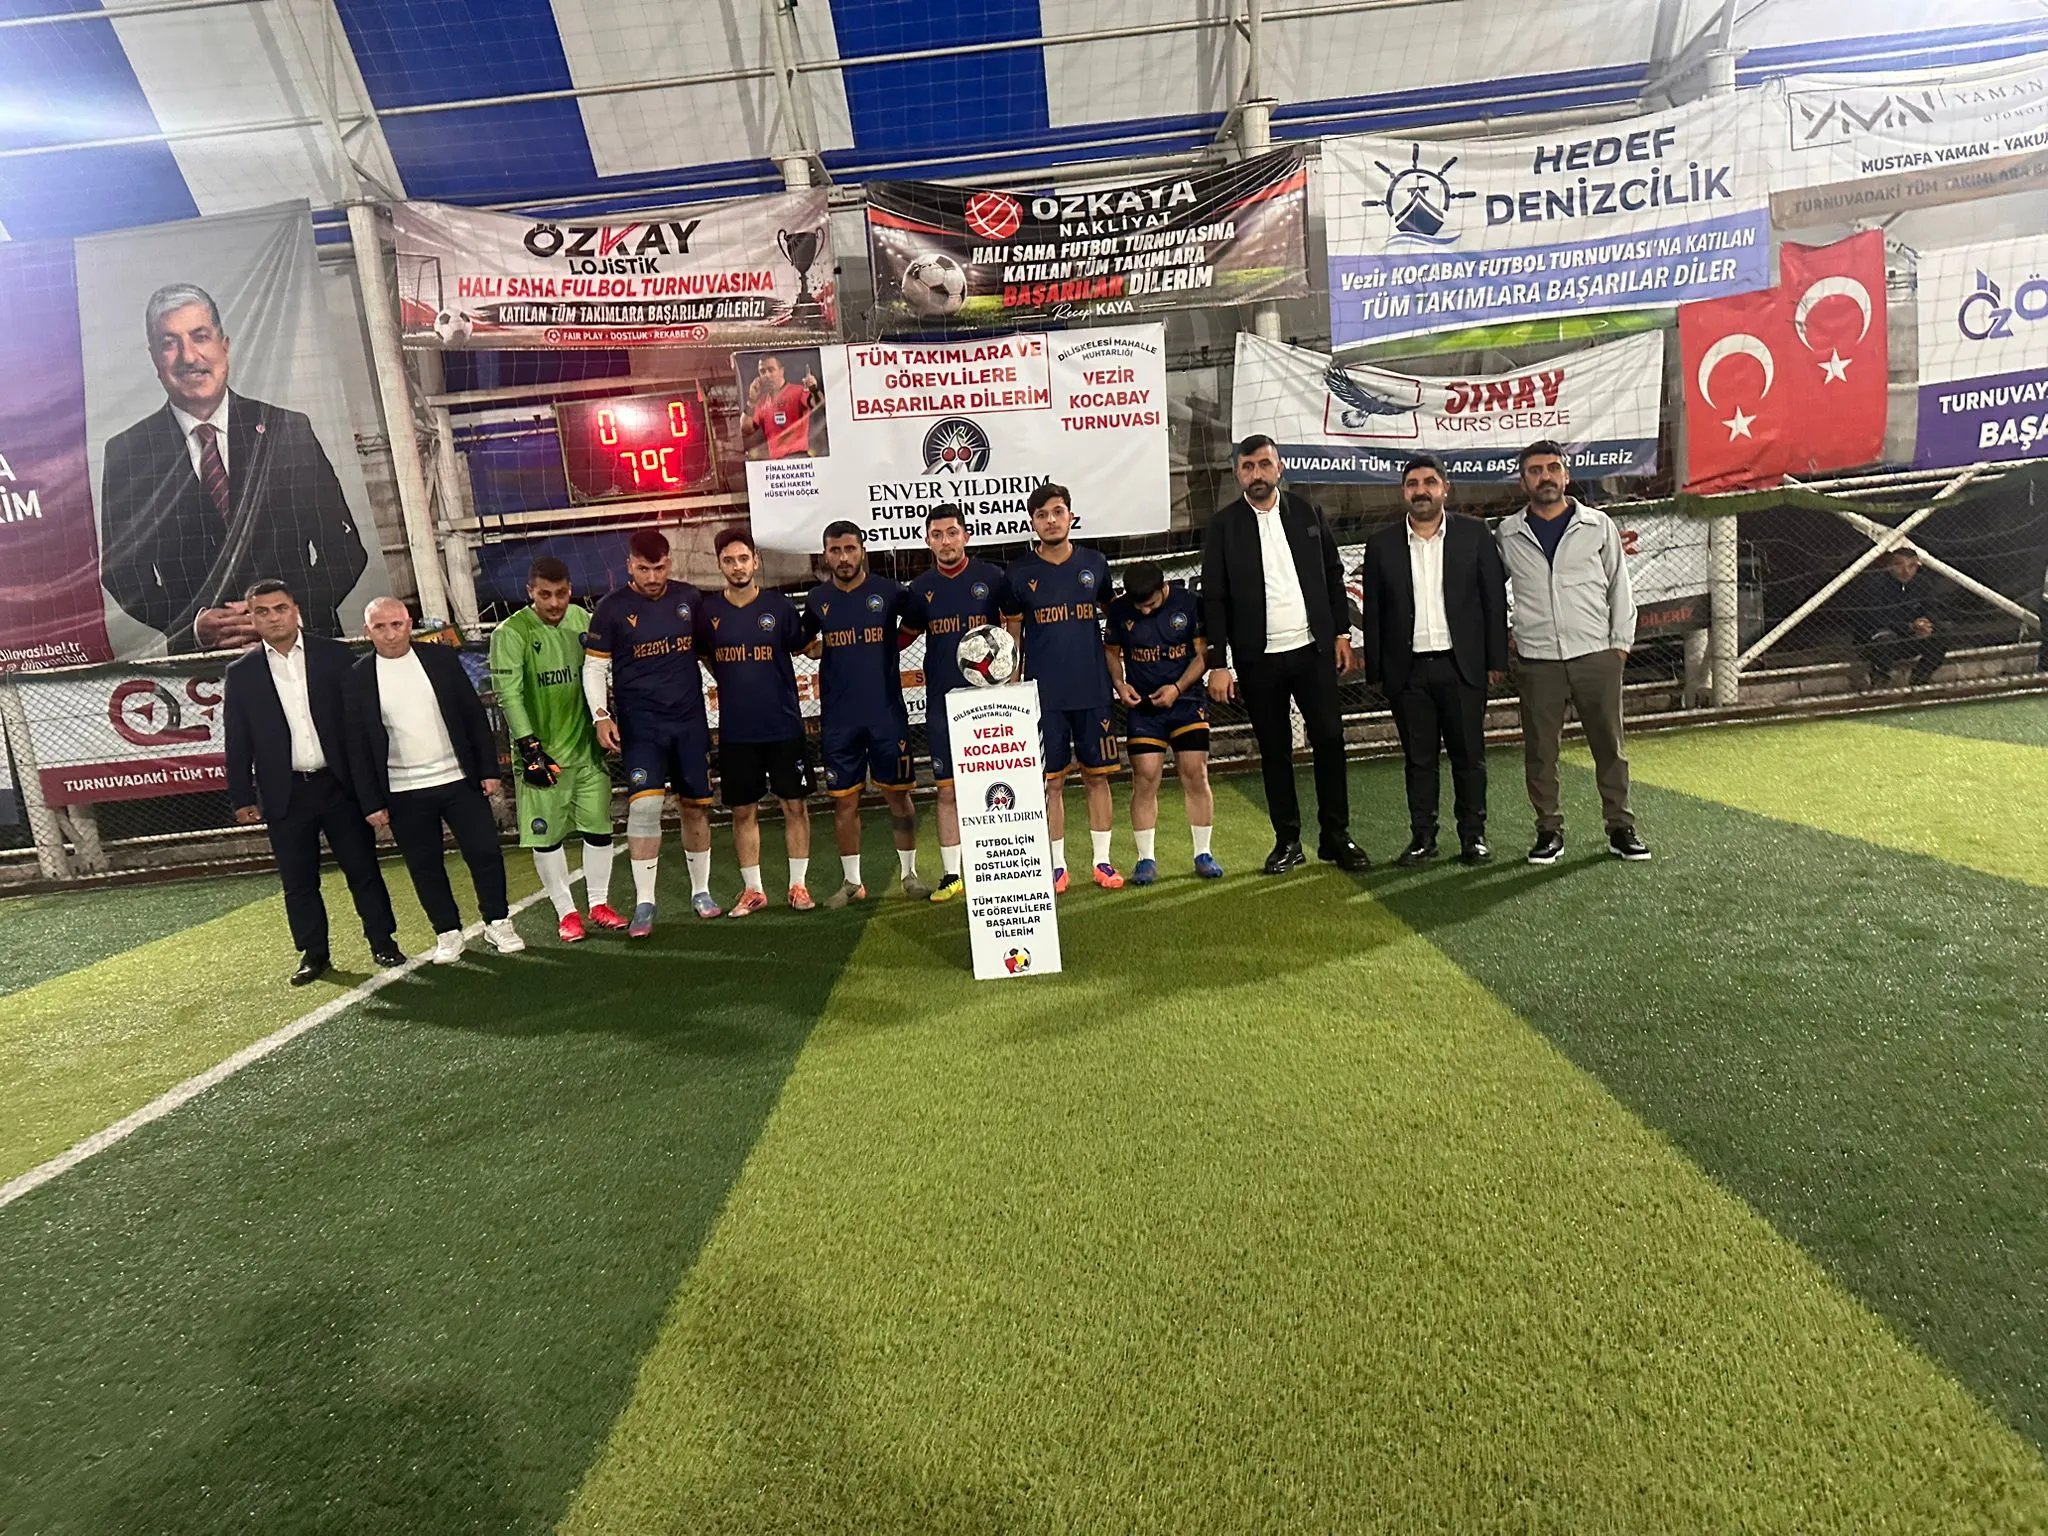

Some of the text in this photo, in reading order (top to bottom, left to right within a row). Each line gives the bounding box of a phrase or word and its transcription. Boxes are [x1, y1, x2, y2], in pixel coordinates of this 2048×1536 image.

[1955, 79, 2044, 105] YAMAN
[1983, 103, 2048, 123] OTOMOT
[1533, 125, 1676, 175] HEDEF
[1861, 152, 1933, 173] MUSTAFA
[1935, 142, 1990, 162] YAMAN
[1485, 161, 1733, 226] DENİZCİLİK
[1793, 183, 1901, 213] TURNUVADAKİ
[1906, 179, 1938, 196] TÜM
[1059, 211, 1172, 238] NAKLİYAT
[523, 220, 702, 257] ÖZKAY
[972, 221, 1236, 265] HALI SAHA FUTBOL TURNUVASINA
[1003, 246, 1206, 283] KATILAN TÜM TAKIMLARA
[1341, 268, 1388, 292] Vezir
[1391, 260, 1477, 286] KOCABAY
[1479, 253, 1547, 278] FUTBOL
[1686, 227, 1756, 254] KATILAN
[458, 271, 774, 298] HALI SAHA FULBOL TURNUVASINA
[1003, 264, 1215, 309] BAŞARILAR DİLERİM
[1362, 257, 1737, 321] TÜM TAKIMLARA BAŞARILAR DİLER
[499, 298, 766, 326] KATILAN TÜM TAKIMLARA BAŞARILAR DİLERİZ!
[1096, 300, 1135, 316] KAYA
[563, 329, 691, 341] FAIR PLAY DOSTLUK REKABET
[856, 341, 1042, 367] TÜM TAKIMLARA VE
[1082, 348, 1134, 361] MUHTARLIĞI
[1114, 338, 1158, 355] MAHALLE
[885, 367, 1018, 390] GÖREVLİLERE
[1083, 365, 1135, 386] VEZİR
[857, 385, 1049, 418] BAŞARILAR DİLERİM
[1069, 389, 1150, 409] KOCABAY
[1444, 368, 1565, 415] SINAV
[1938, 381, 2048, 414] TURNUVAY
[597, 402, 688, 445] 0 0
[1060, 411, 1160, 431] TURNUVASI
[1434, 409, 1571, 432] KURS GEBZE
[765, 461, 814, 473] FİNAL HAKEMİ
[1282, 455, 1356, 471] NUVADAKİ
[1359, 456, 1391, 472] TÜM
[1575, 448, 1633, 467] DİLERİZ
[770, 480, 812, 489] ESKİ HAKEM
[782, 471, 815, 480] KOKARTLI
[764, 488, 820, 498] HÜSEYİN GÖÇEK
[868, 474, 1050, 502] ENVER YILDIRIM
[979, 498, 1027, 515] SAHA
[860, 525, 923, 543] OSTLUK
[965, 519, 992, 537] BİR
[1076, 603, 1094, 620] DER
[864, 626, 884, 643] DER
[754, 646, 773, 661] DER
[537, 665, 573, 688] NEZOYİ
[972, 710, 1013, 721] MUHTARLIĞI
[996, 703, 1031, 716] MAHALLE
[973, 723, 1014, 740] VEZİR
[963, 740, 1027, 757] KOCABAY
[1100, 735, 1118, 761] 10
[958, 756, 1036, 774] TURNUVASI
[63, 767, 169, 792] TURNUVADAKİ
[169, 766, 203, 783] TÜM
[962, 810, 1044, 827] ENVER YILDIRIM
[975, 835, 1035, 848] FUTBOL İÇİN
[986, 847, 1027, 859] SAHADA
[974, 858, 1041, 872] DOSTLUK İÇİN
[975, 869, 1042, 883] BİR ARADAYIZ
[972, 891, 1050, 906] TÜM TAKIMLARA
[972, 902, 1053, 918] VE GÖREVLİLERE
[986, 915, 1041, 929] BAŞARILAR
[995, 926, 1034, 939] DİLERİM
